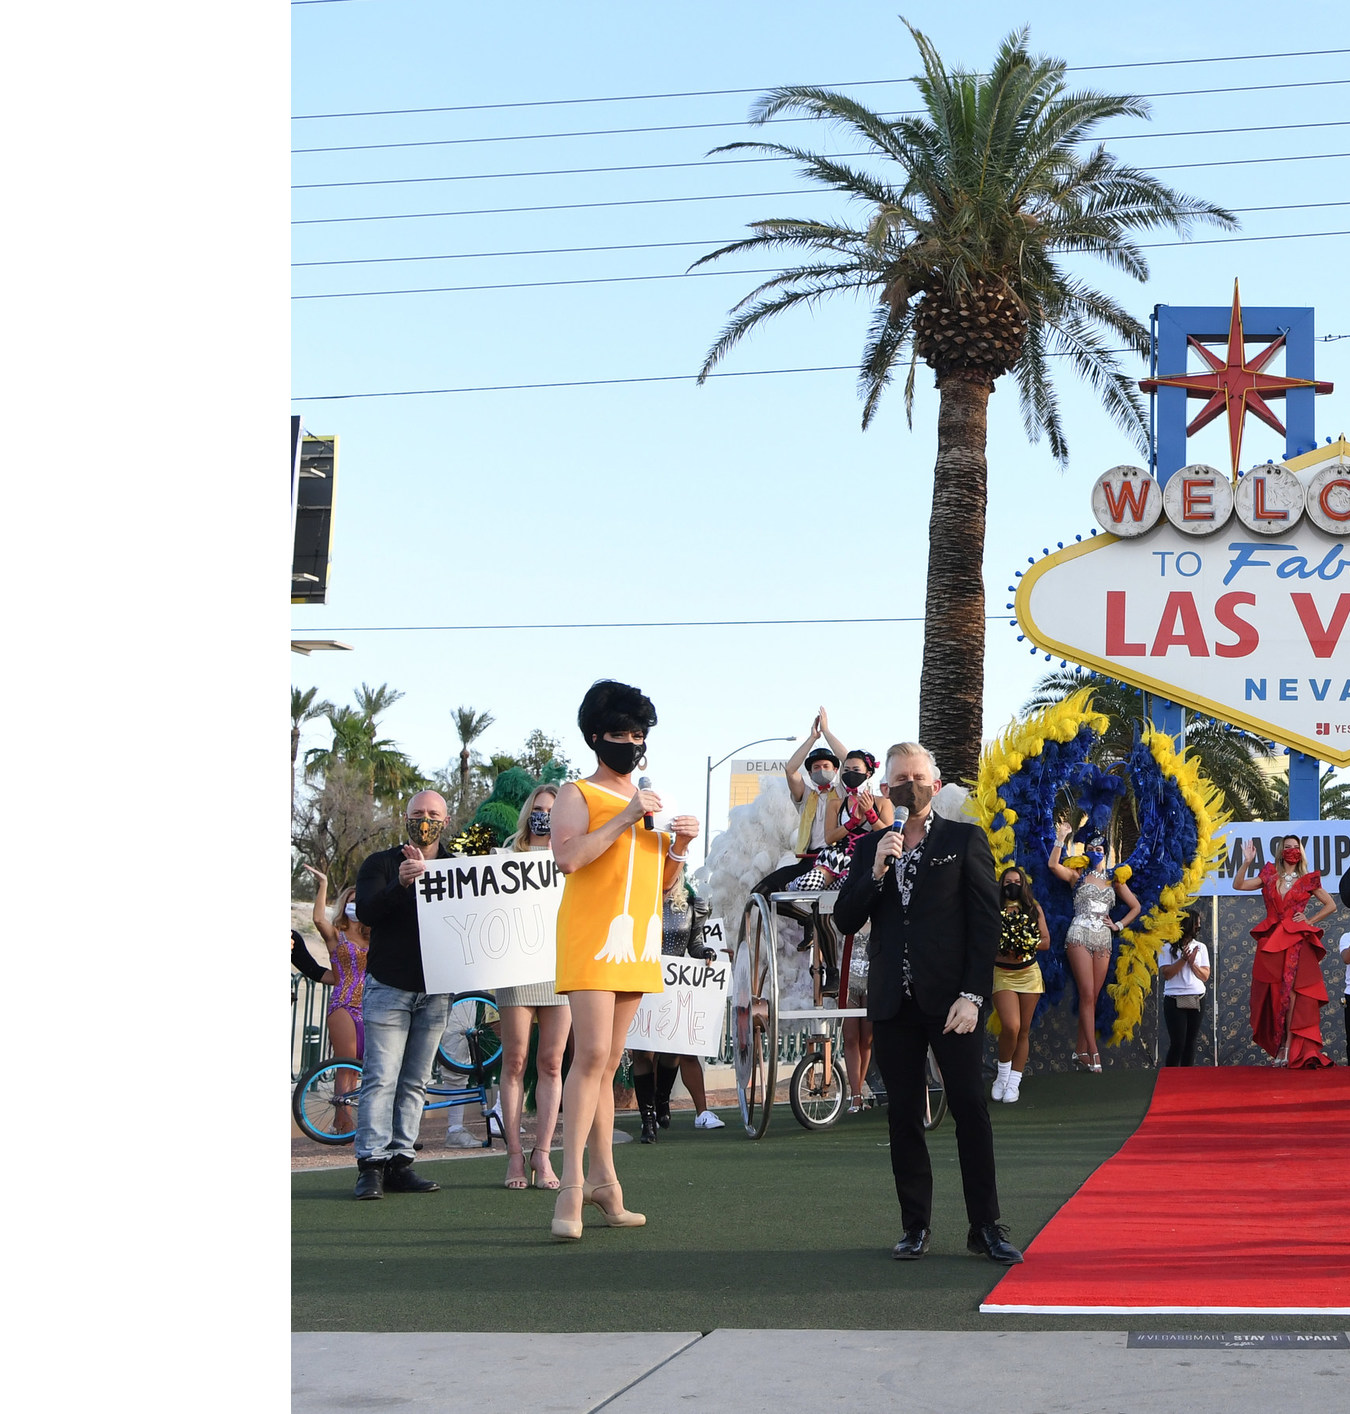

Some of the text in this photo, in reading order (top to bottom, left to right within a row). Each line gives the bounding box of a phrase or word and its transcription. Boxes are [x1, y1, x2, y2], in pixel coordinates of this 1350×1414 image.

[1152, 550, 1203, 578] TO
[1105, 590, 1260, 659] LAS
[443, 904, 545, 965] YOU
